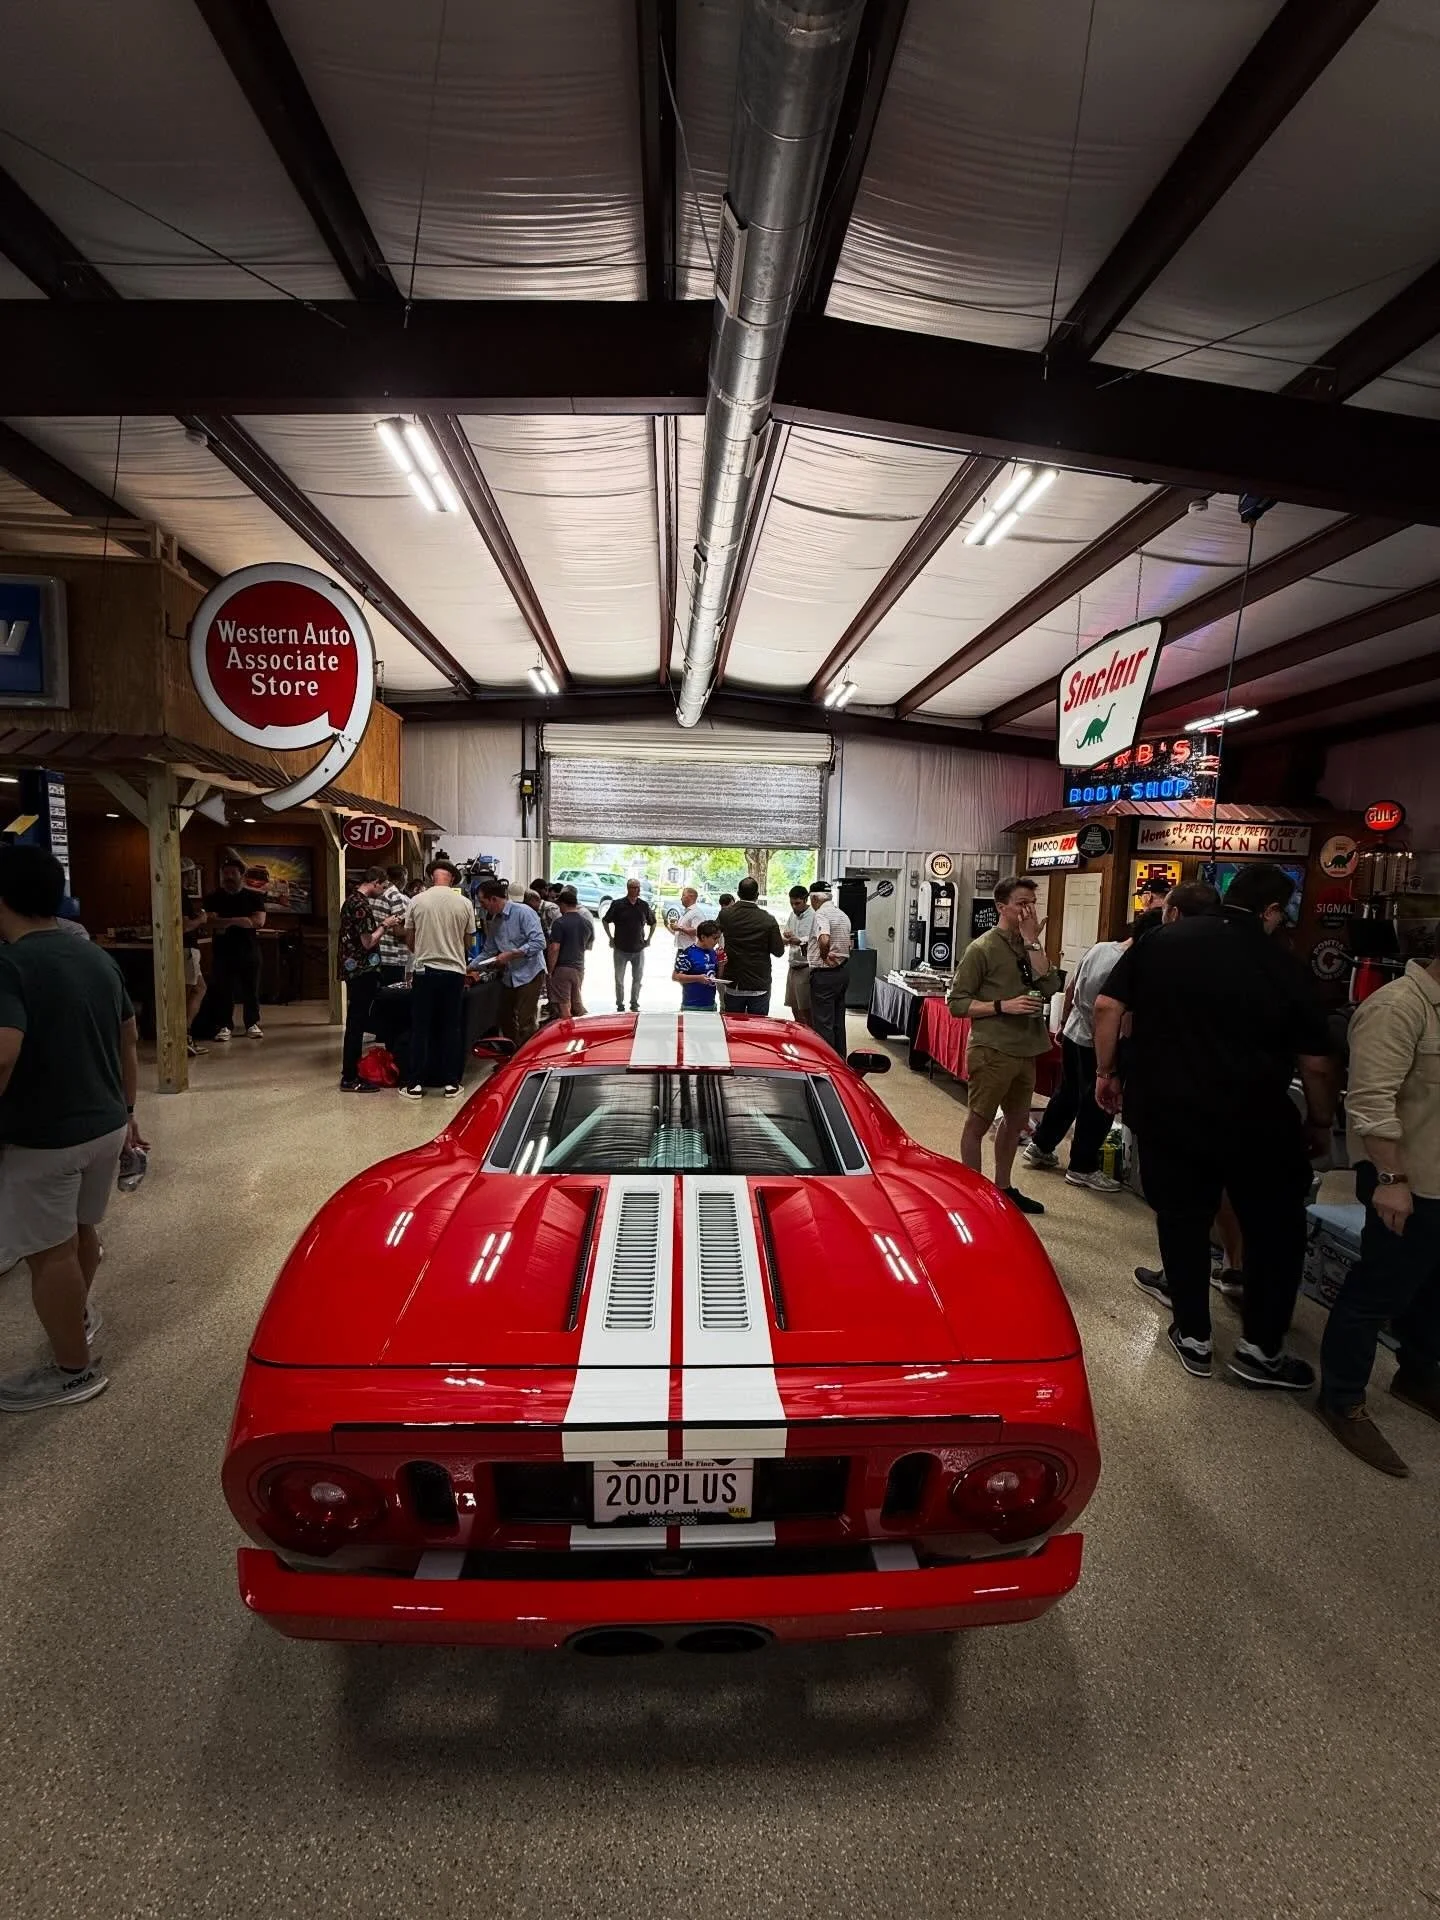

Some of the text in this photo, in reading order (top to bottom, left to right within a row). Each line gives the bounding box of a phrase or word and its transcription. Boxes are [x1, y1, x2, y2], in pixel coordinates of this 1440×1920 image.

[216, 619, 351, 646] Western Auto
[225, 646, 339, 671] Associate
[251, 672, 319, 696] Store
[1063, 646, 1150, 713] Sinclair
[1069, 778, 1189, 804] BODY SHOP
[1367, 808, 1400, 824] GULF
[349, 818, 387, 843] STP
[1140, 827, 1172, 845] Home
[1172, 822, 1184, 839] of
[1184, 822, 1215, 836] PRETTY
[1245, 826, 1274, 838] PRETTY
[1277, 827, 1298, 838] CARS
[1031, 840, 1059, 853] AMOCO
[1192, 836, 1233, 851] ROCK
[1257, 838, 1297, 853] ROLL
[1030, 854, 1077, 867] SUPER TIRE
[1316, 903, 1353, 915] SIGNAL
[62, 1371, 95, 1391] HOKA
[606, 1472, 737, 1506] 200PLUS
